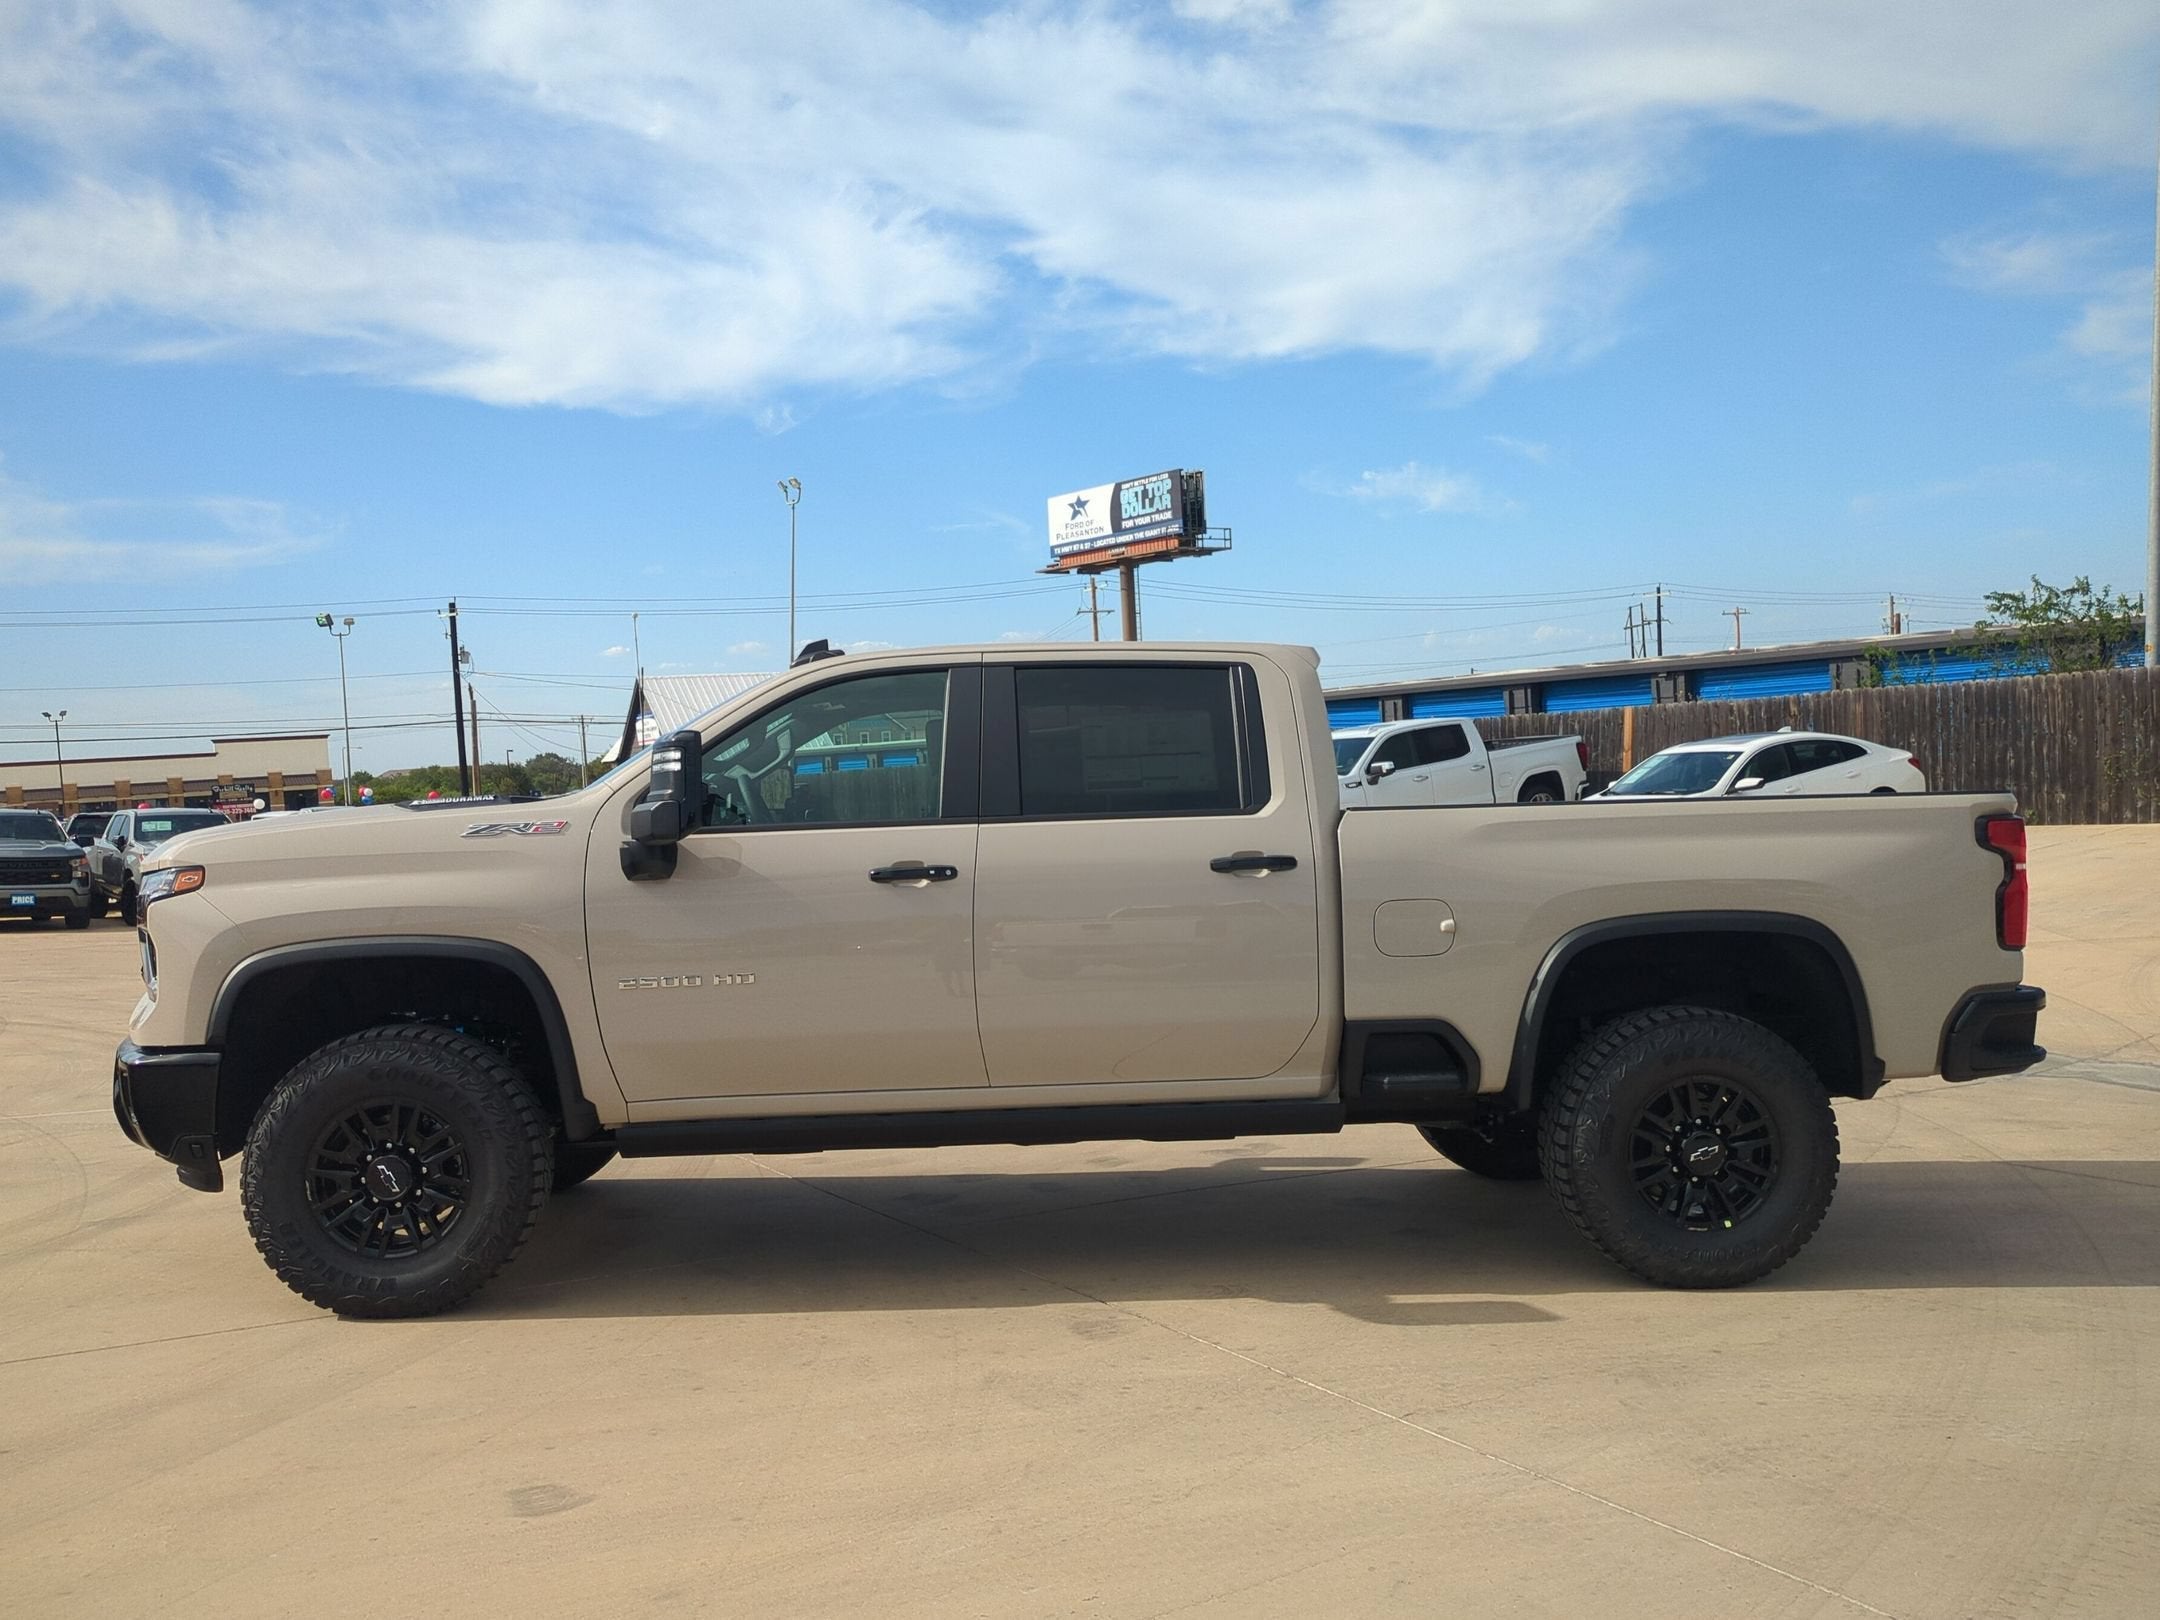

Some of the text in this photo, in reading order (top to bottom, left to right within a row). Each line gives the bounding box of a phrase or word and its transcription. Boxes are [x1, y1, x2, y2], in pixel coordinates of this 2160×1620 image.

[1120, 478, 1172, 504] GET TOP
[1121, 493, 1171, 519] DOLLAR
[1085, 519, 1095, 527] OF
[1121, 510, 1173, 529] FOR YOUR TRADE
[1094, 536, 1116, 548] LOCATED
[1116, 533, 1134, 544] UNDER
[1134, 530, 1144, 540] THE
[445, 794, 495, 803] DURAMAX
[460, 820, 569, 838] ZR2
[11, 895, 35, 905] PRICE
[618, 972, 756, 990] 2500 HD
